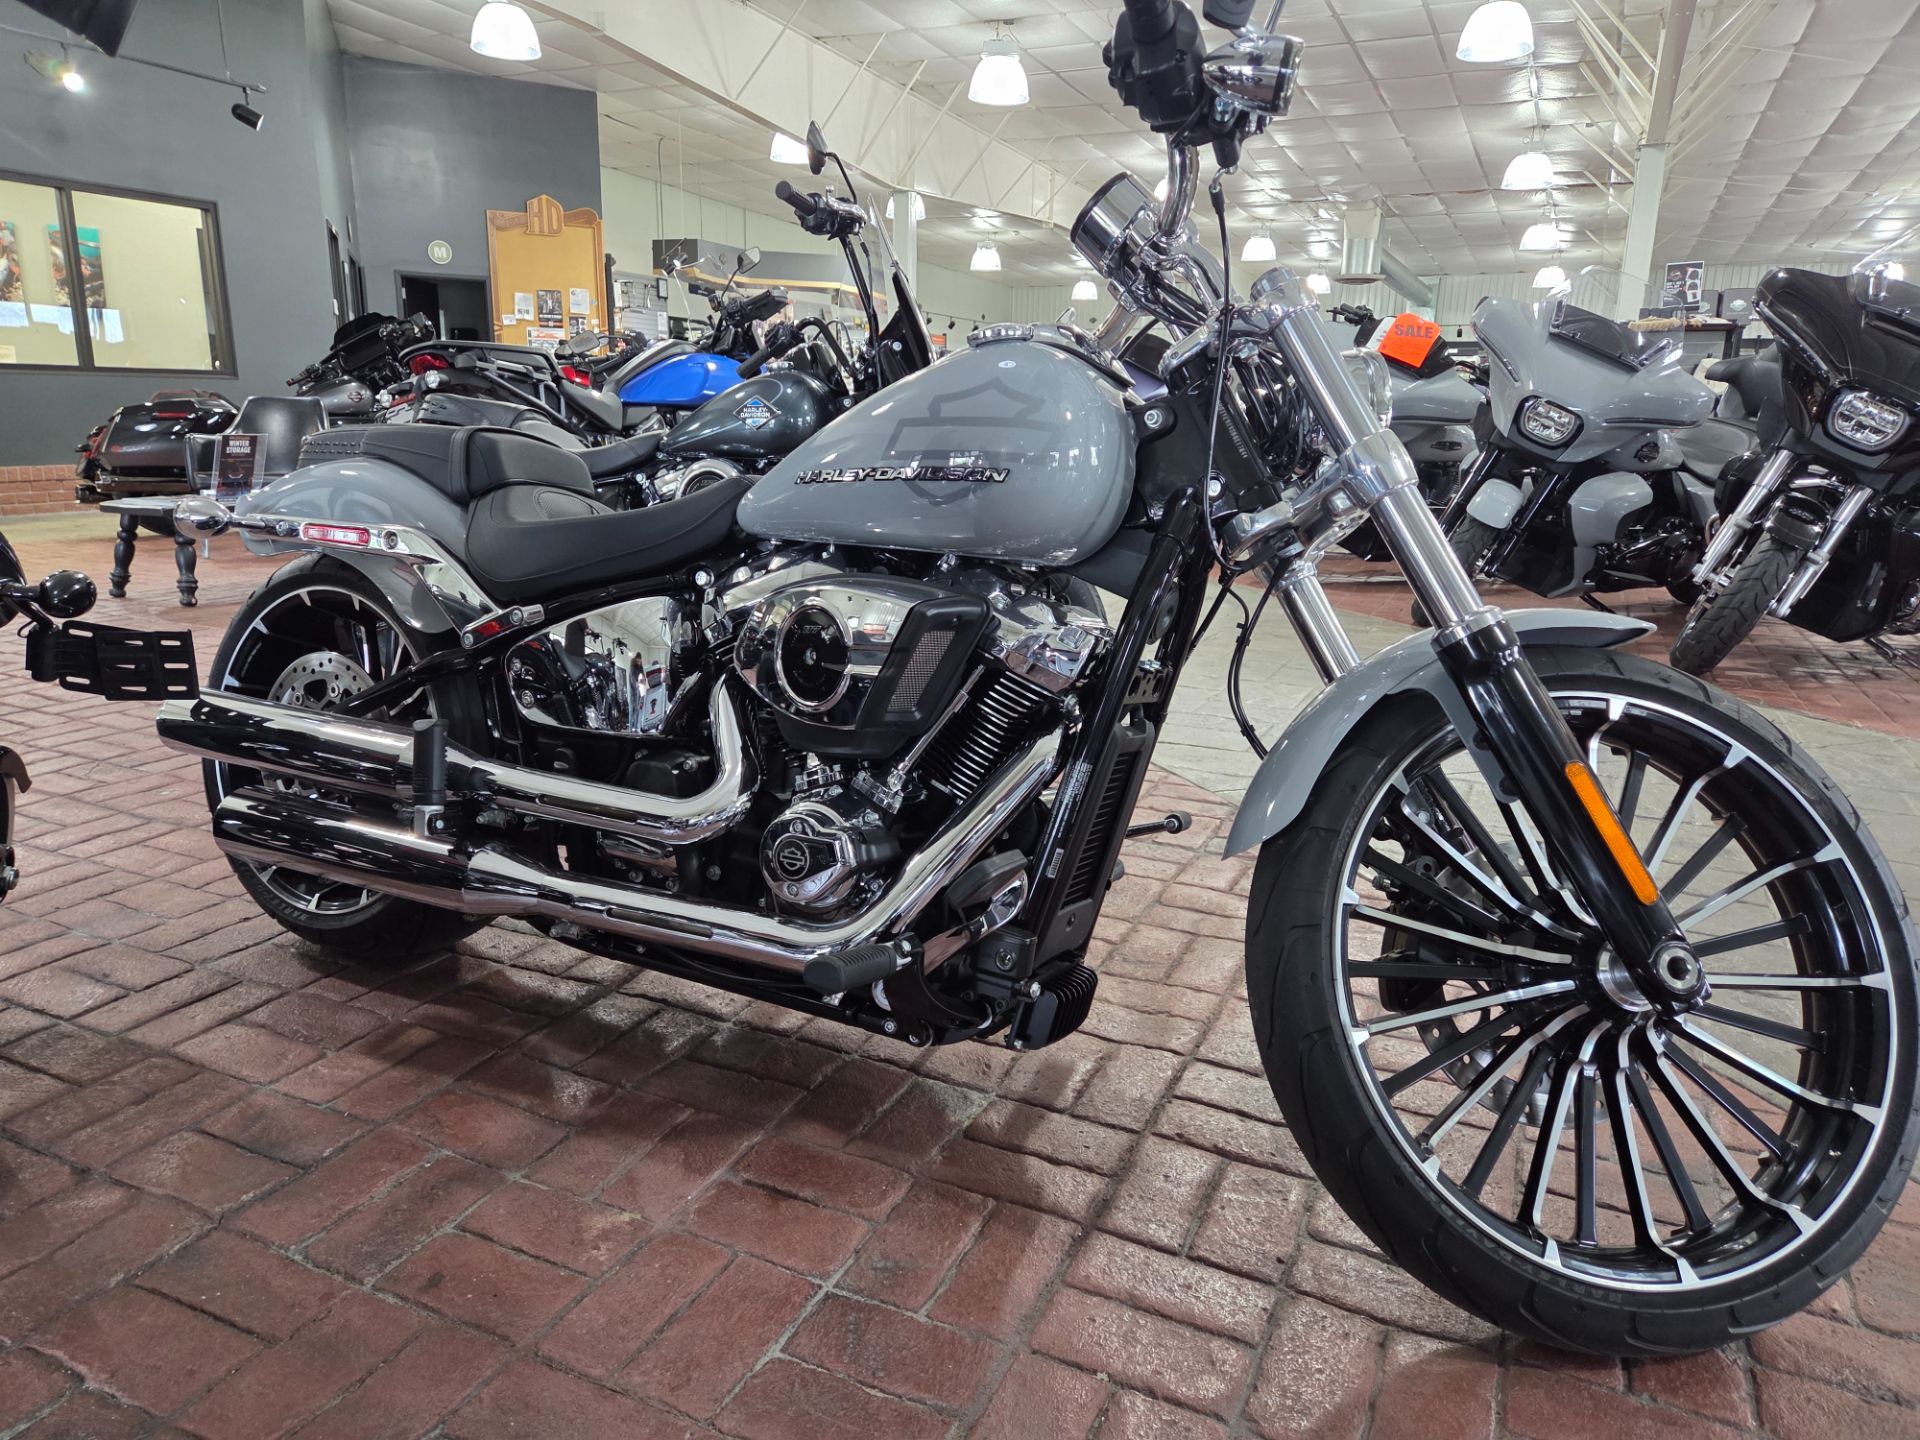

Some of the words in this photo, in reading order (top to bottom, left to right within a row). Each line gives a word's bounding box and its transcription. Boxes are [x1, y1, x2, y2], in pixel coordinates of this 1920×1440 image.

[528, 198, 563, 235] HD
[1394, 323, 1433, 339] SALE
[226, 446, 251, 454] STORAGE
[795, 466, 1010, 484] HARLEY-DAVIDSON
